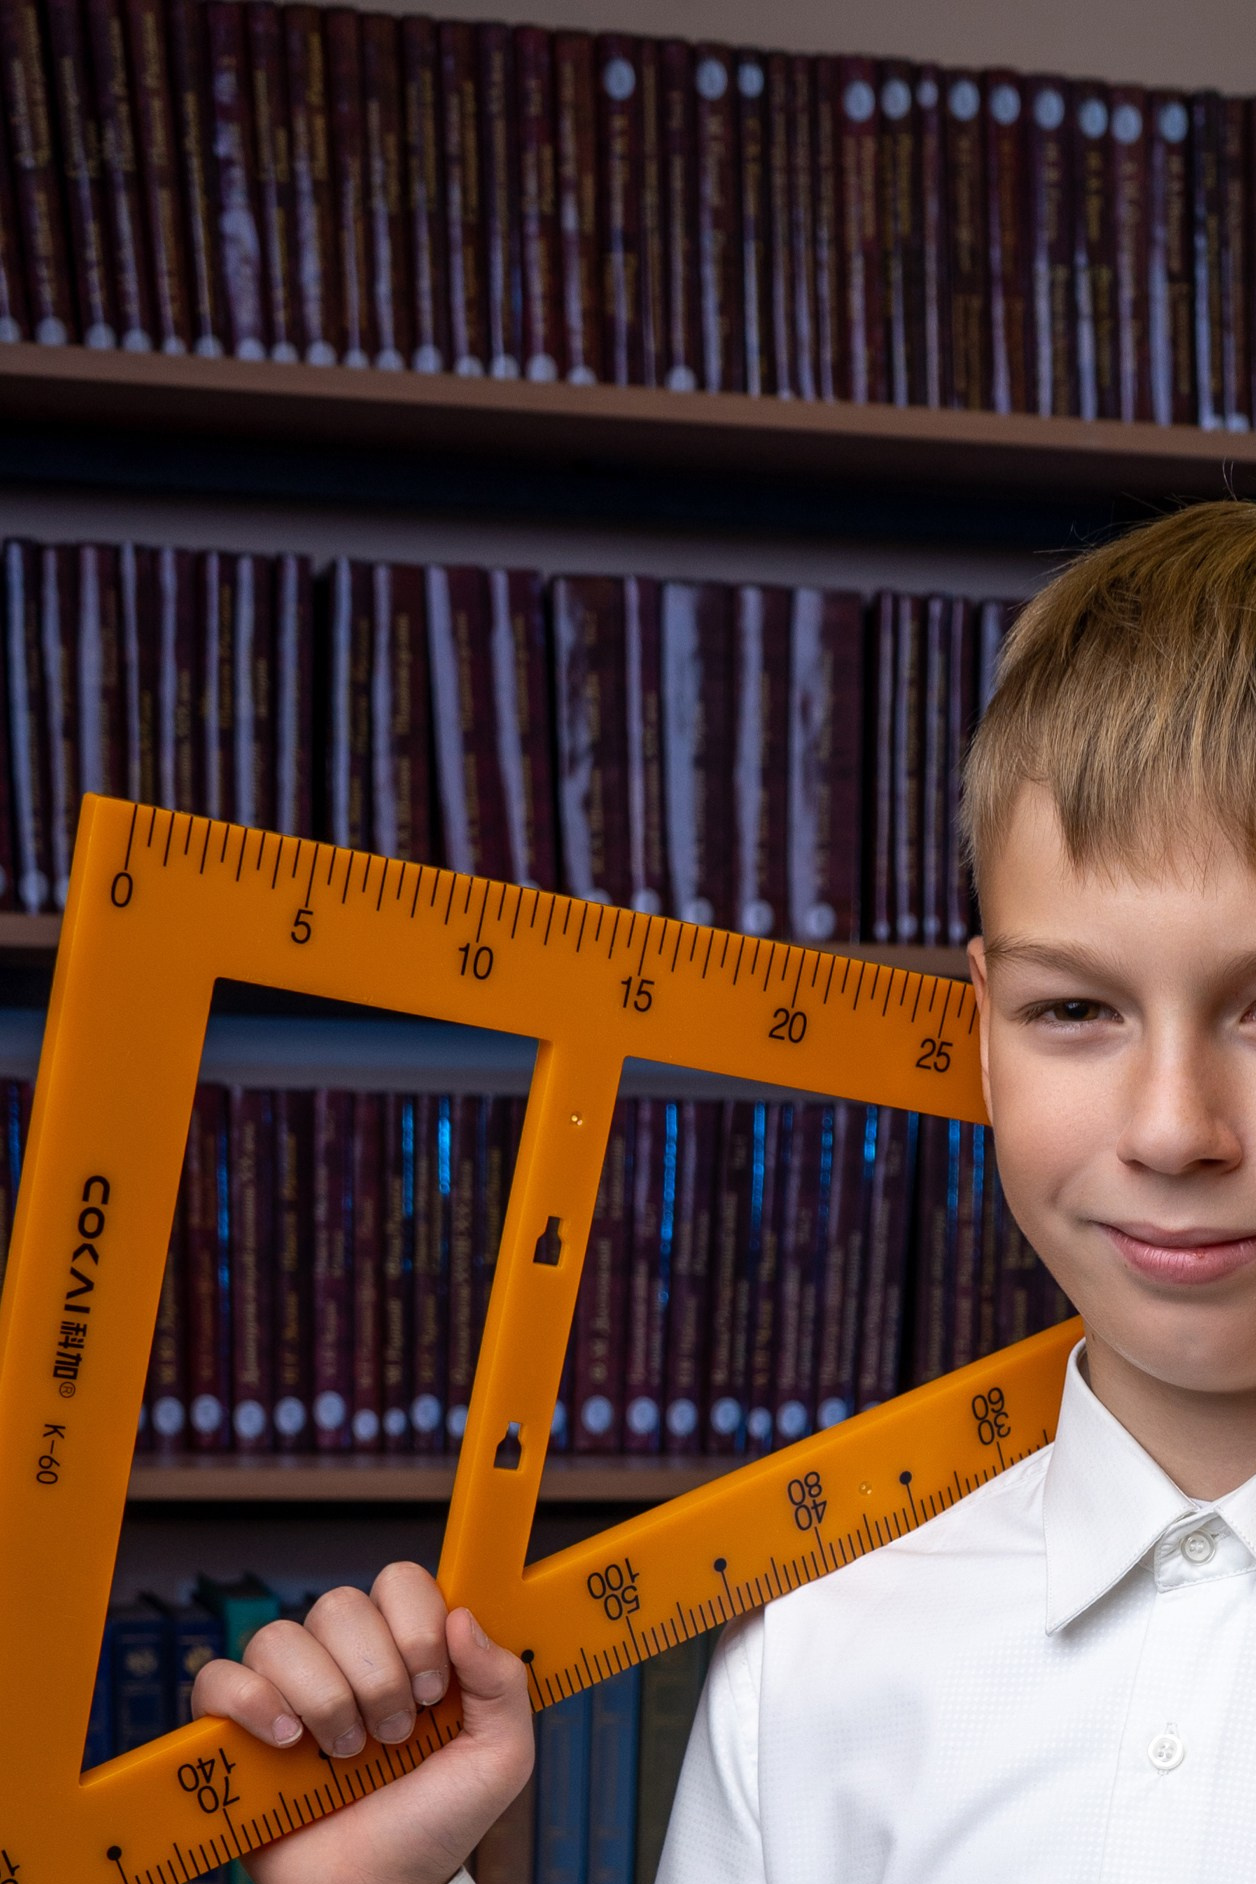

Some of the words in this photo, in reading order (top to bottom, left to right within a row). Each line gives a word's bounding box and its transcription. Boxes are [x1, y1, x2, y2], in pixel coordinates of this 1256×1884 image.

[110, 871, 134, 909] 0
[290, 908, 314, 945] 5
[458, 942, 495, 981] 10
[620, 975, 655, 1013] 15
[768, 1007, 808, 1045] 20
[914, 1037, 954, 1074] 25
[63, 1174, 111, 1315] COKAI
[971, 1387, 1006, 1421] 60
[977, 1417, 1011, 1448] 30
[35, 1423, 67, 1485] K-60
[787, 1470, 823, 1507] 80
[793, 1498, 829, 1532] 40
[586, 1556, 640, 1601] 100
[603, 1585, 642, 1623] 50
[177, 1747, 237, 1793] 140
[197, 1776, 241, 1815] 70
